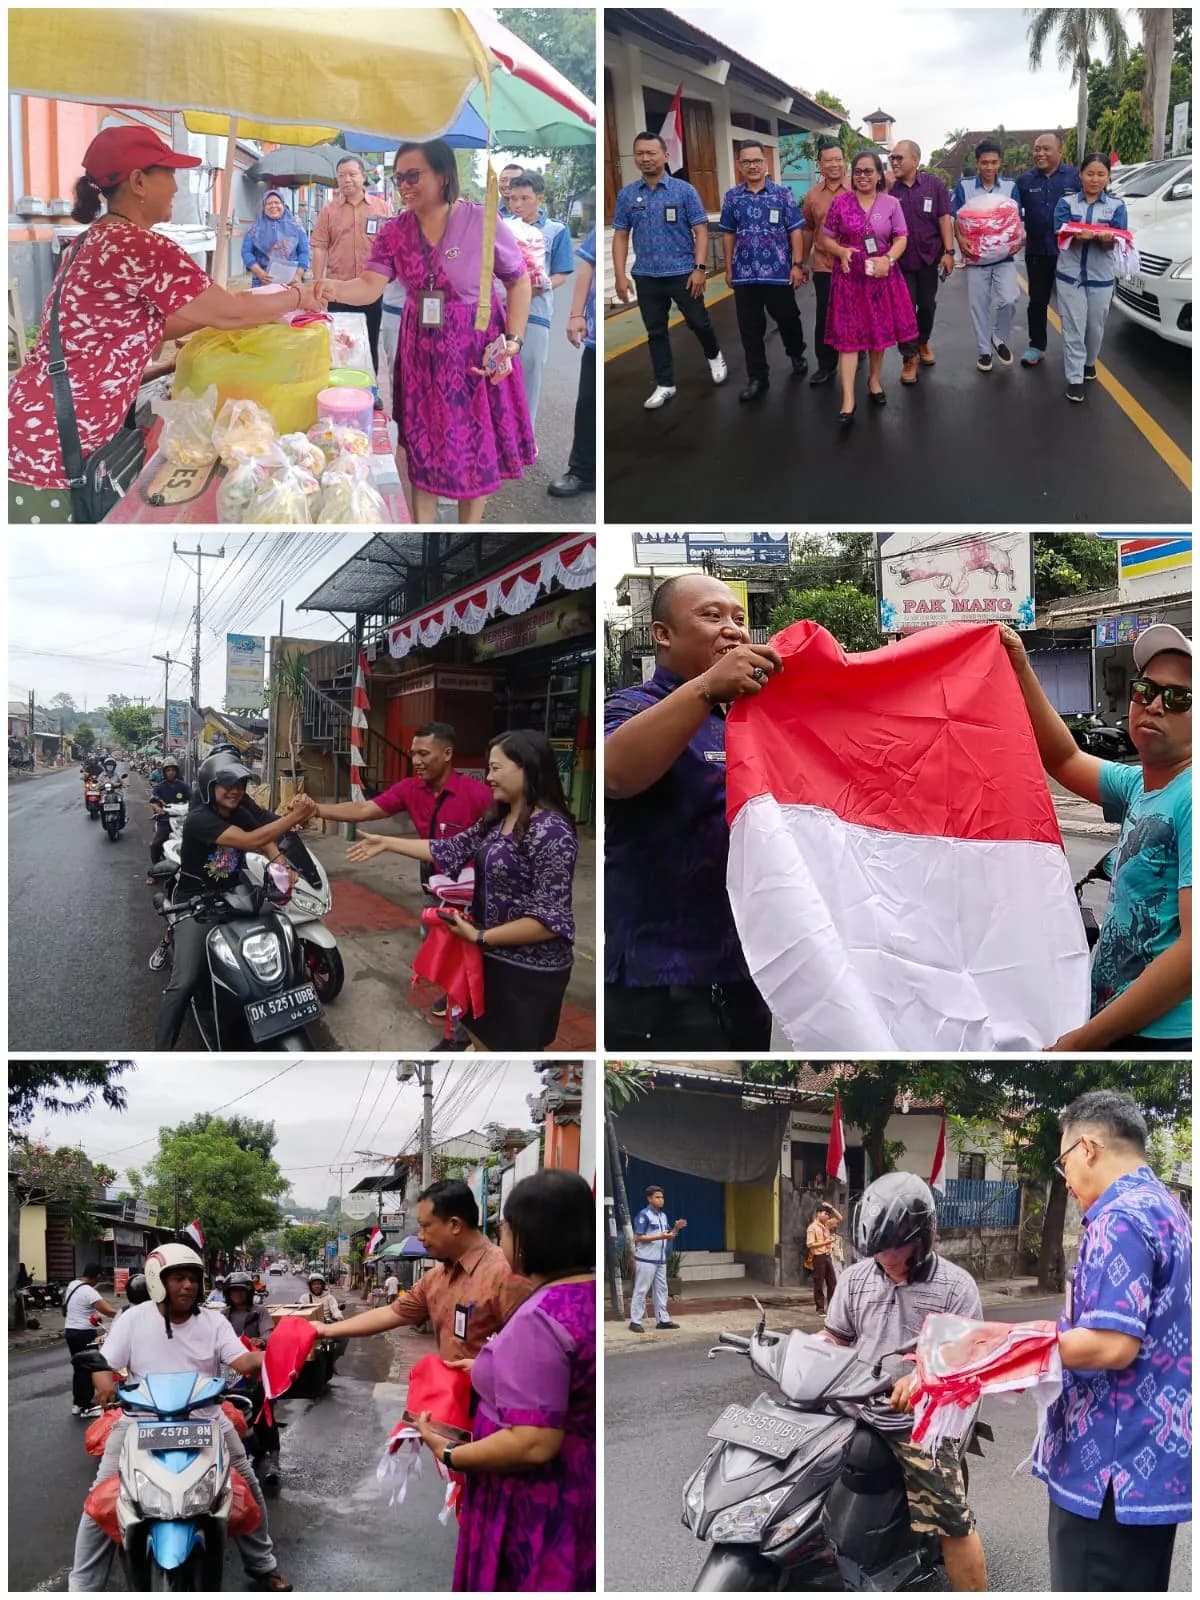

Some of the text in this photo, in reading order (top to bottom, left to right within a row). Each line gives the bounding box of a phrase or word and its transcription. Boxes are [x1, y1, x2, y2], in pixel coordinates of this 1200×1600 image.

[166, 468, 199, 489] ES
[903, 598, 1013, 614] PAK MANG
[251, 988, 314, 1021] DK 5251 UBB
[722, 1406, 745, 1422] DK
[140, 1428, 155, 1439] DK
[160, 1426, 189, 1437] 4578
